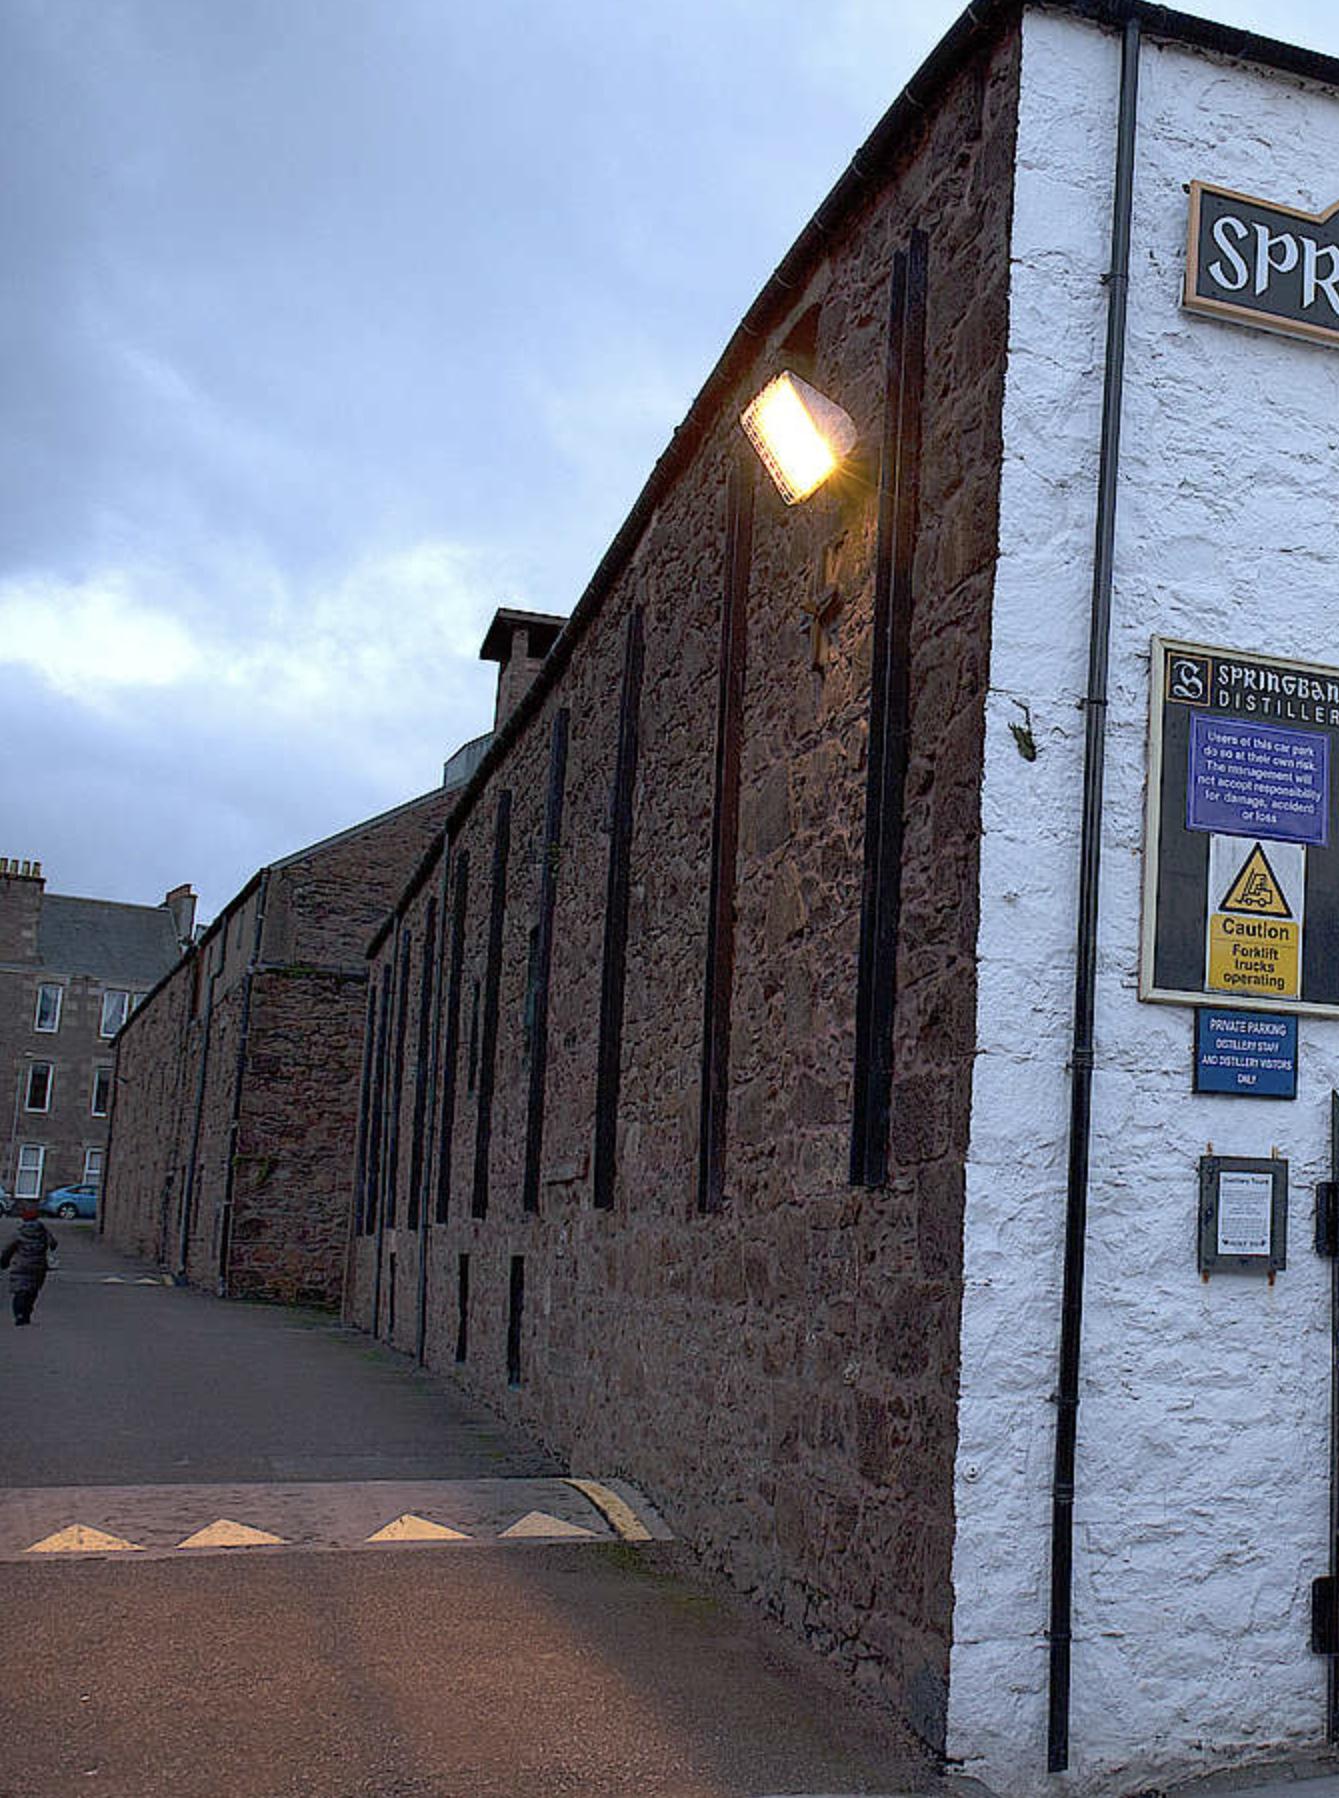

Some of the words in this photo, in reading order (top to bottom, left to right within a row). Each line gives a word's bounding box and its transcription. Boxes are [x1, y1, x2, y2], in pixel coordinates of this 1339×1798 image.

[1207, 731, 1238, 744] Users
[1240, 737, 1251, 747] of
[1253, 738, 1272, 750] this
[1274, 743, 1290, 753] car
[1292, 745, 1314, 757] park
[1203, 746, 1218, 756] do
[1220, 749, 1232, 759] so
[1235, 750, 1245, 760] at
[1247, 752, 1271, 764] their
[1272, 757, 1294, 768] own
[1207, 760, 1226, 772] The
[1227, 765, 1293, 781] management
[1295, 774, 1313, 785] will
[1197, 775, 1215, 785] not
[1218, 778, 1253, 791] accept
[1254, 782, 1321, 803] responsibility
[1205, 789, 1220, 801] for
[1271, 801, 1315, 814] accident
[1241, 811, 1254, 820] or
[1256, 811, 1277, 823] loss
[1222, 917, 1289, 940] Caution
[1233, 944, 1279, 960] Forklift
[1235, 959, 1275, 973] trucks
[1223, 973, 1285, 990] operating
[1210, 1018, 1247, 1032] PRIVATE
[1247, 1021, 1287, 1036] PARKING
[1216, 1038, 1256, 1051] DISTILLERY
[1257, 1041, 1279, 1053] STAFF
[1201, 1054, 1218, 1066] AND
[1219, 1055, 1259, 1067] DISTILLERY
[1260, 1058, 1293, 1071] VISITORS
[1237, 1073, 1257, 1085] ONLY
